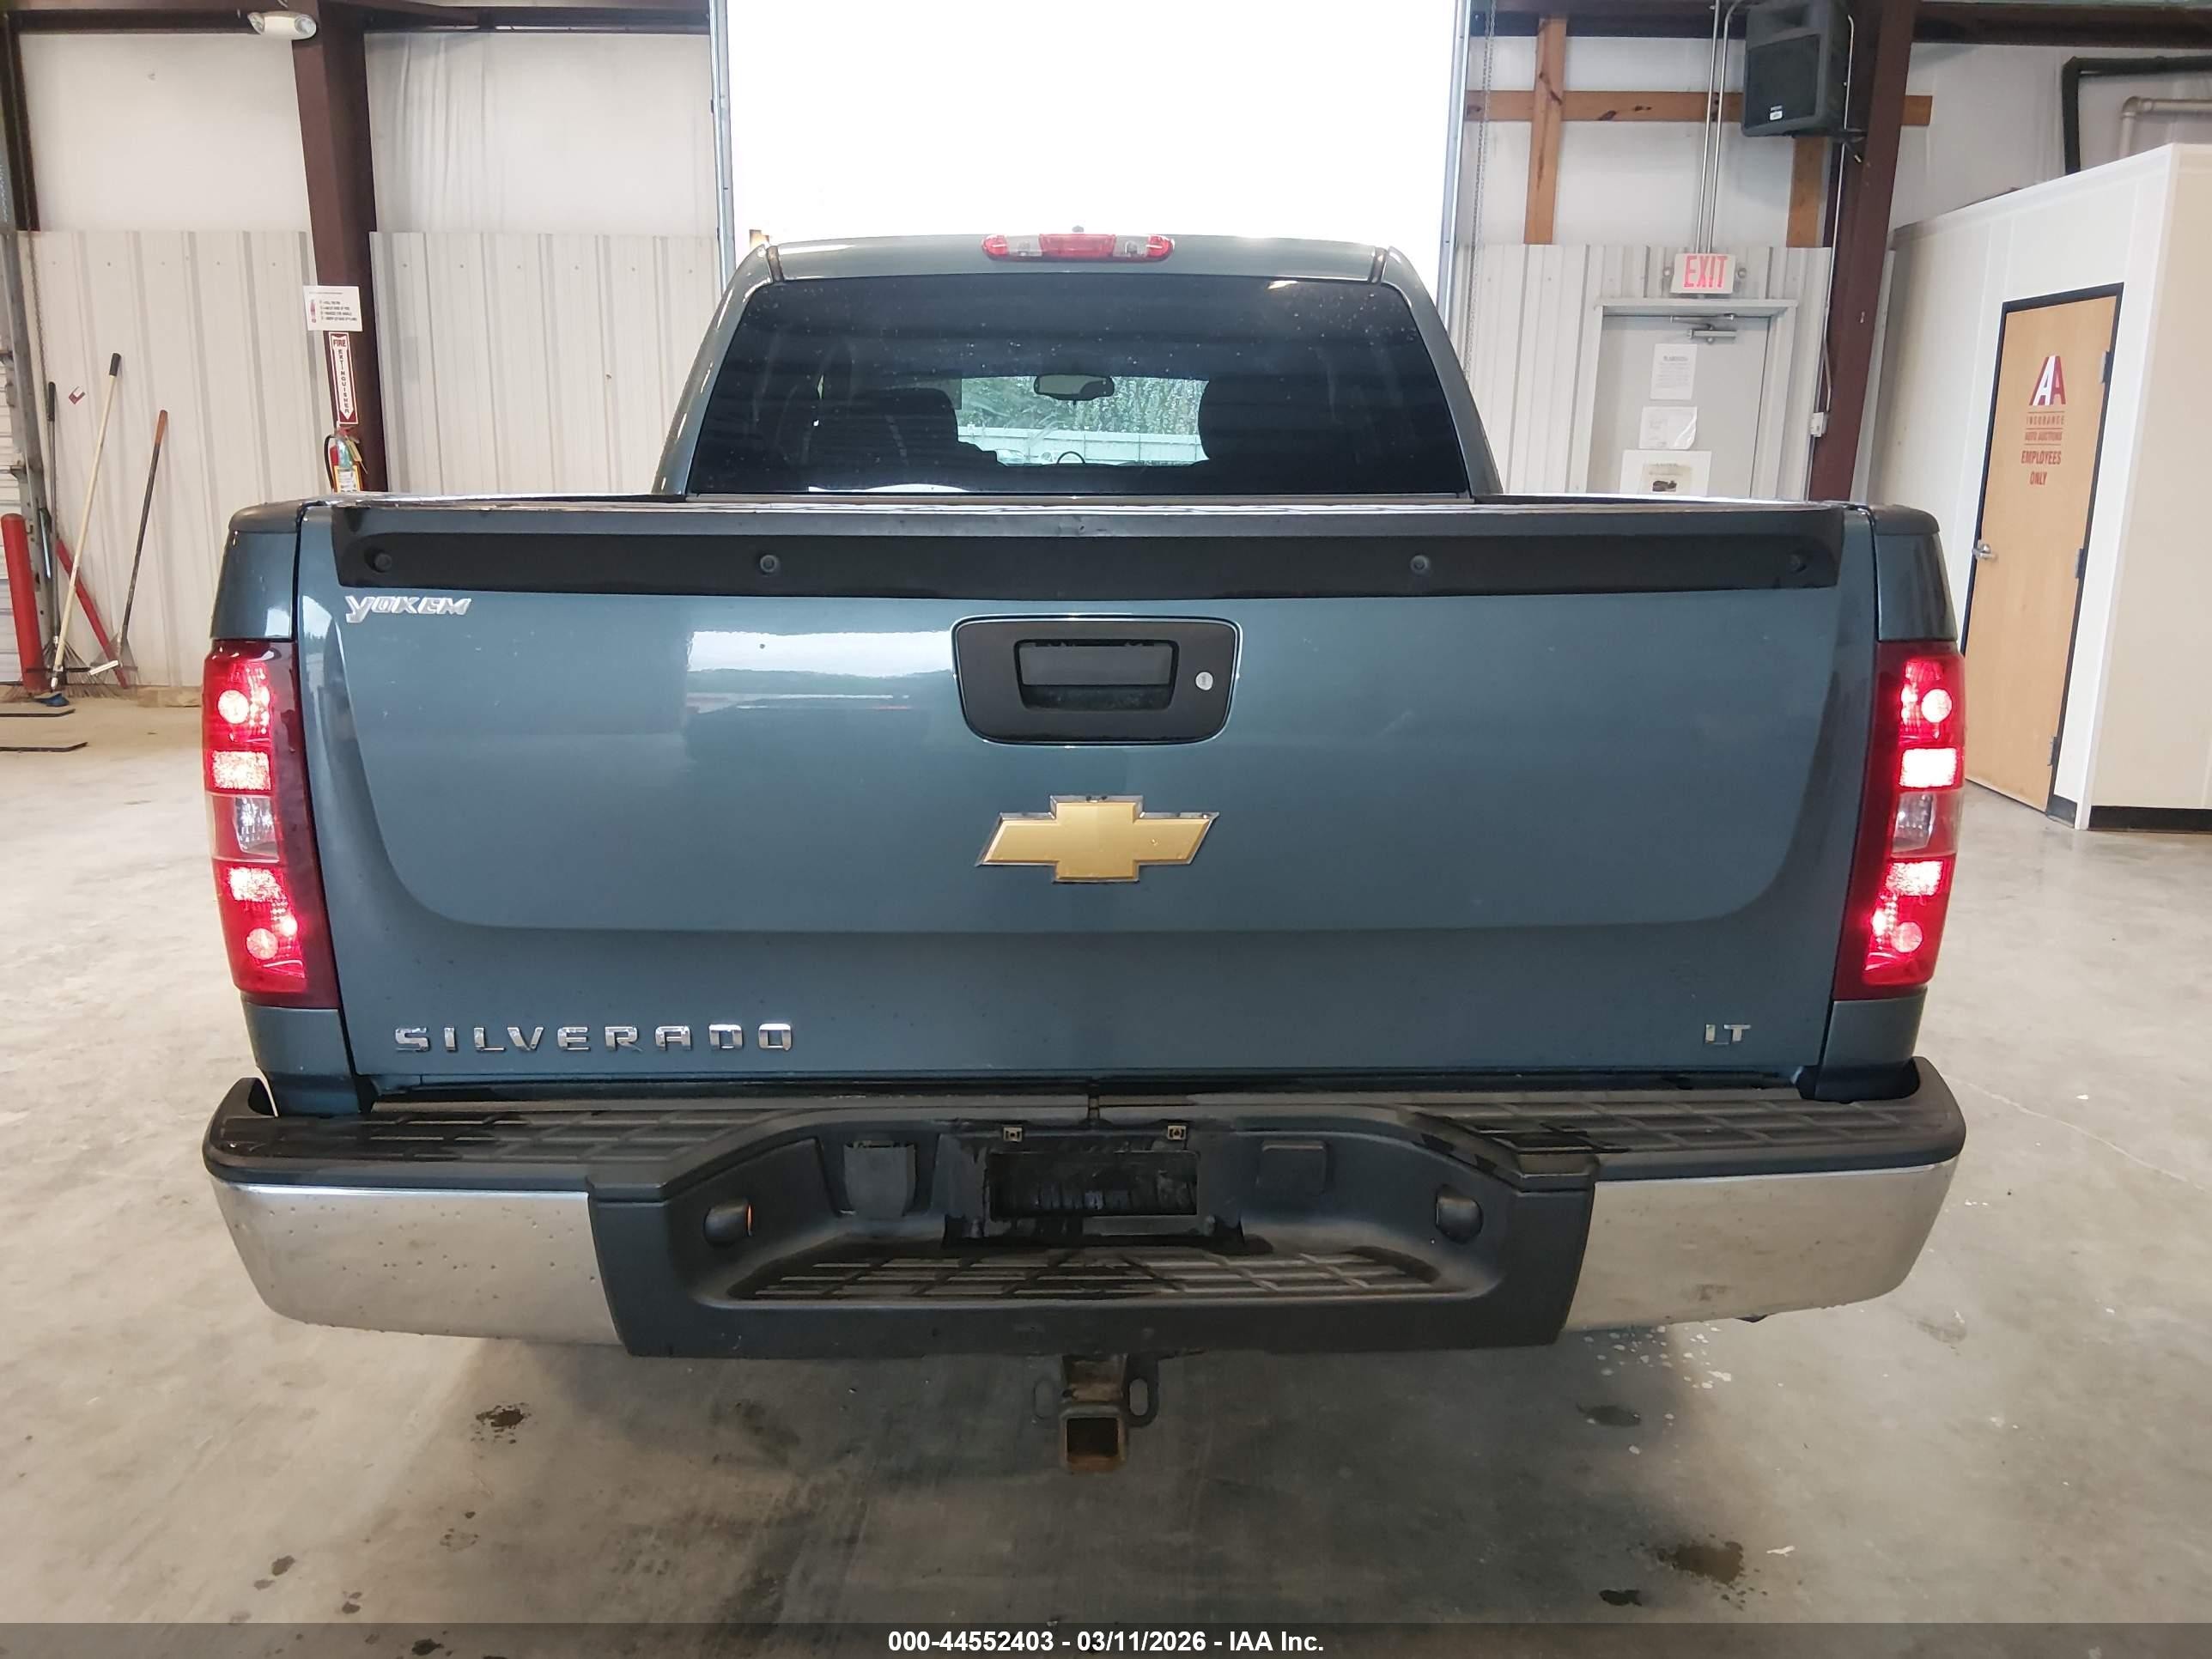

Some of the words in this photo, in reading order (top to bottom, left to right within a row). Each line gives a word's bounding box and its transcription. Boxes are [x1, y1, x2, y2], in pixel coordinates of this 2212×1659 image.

[1683, 255, 1728, 288] EXIT
[337, 349, 350, 414] EXTINGUISHER
[2021, 450, 2062, 465] EMPLOYEES
[2029, 471, 2048, 485] ONLY
[394, 1023, 793, 1053] SILVERADO
[1705, 1024, 1752, 1045] LT
